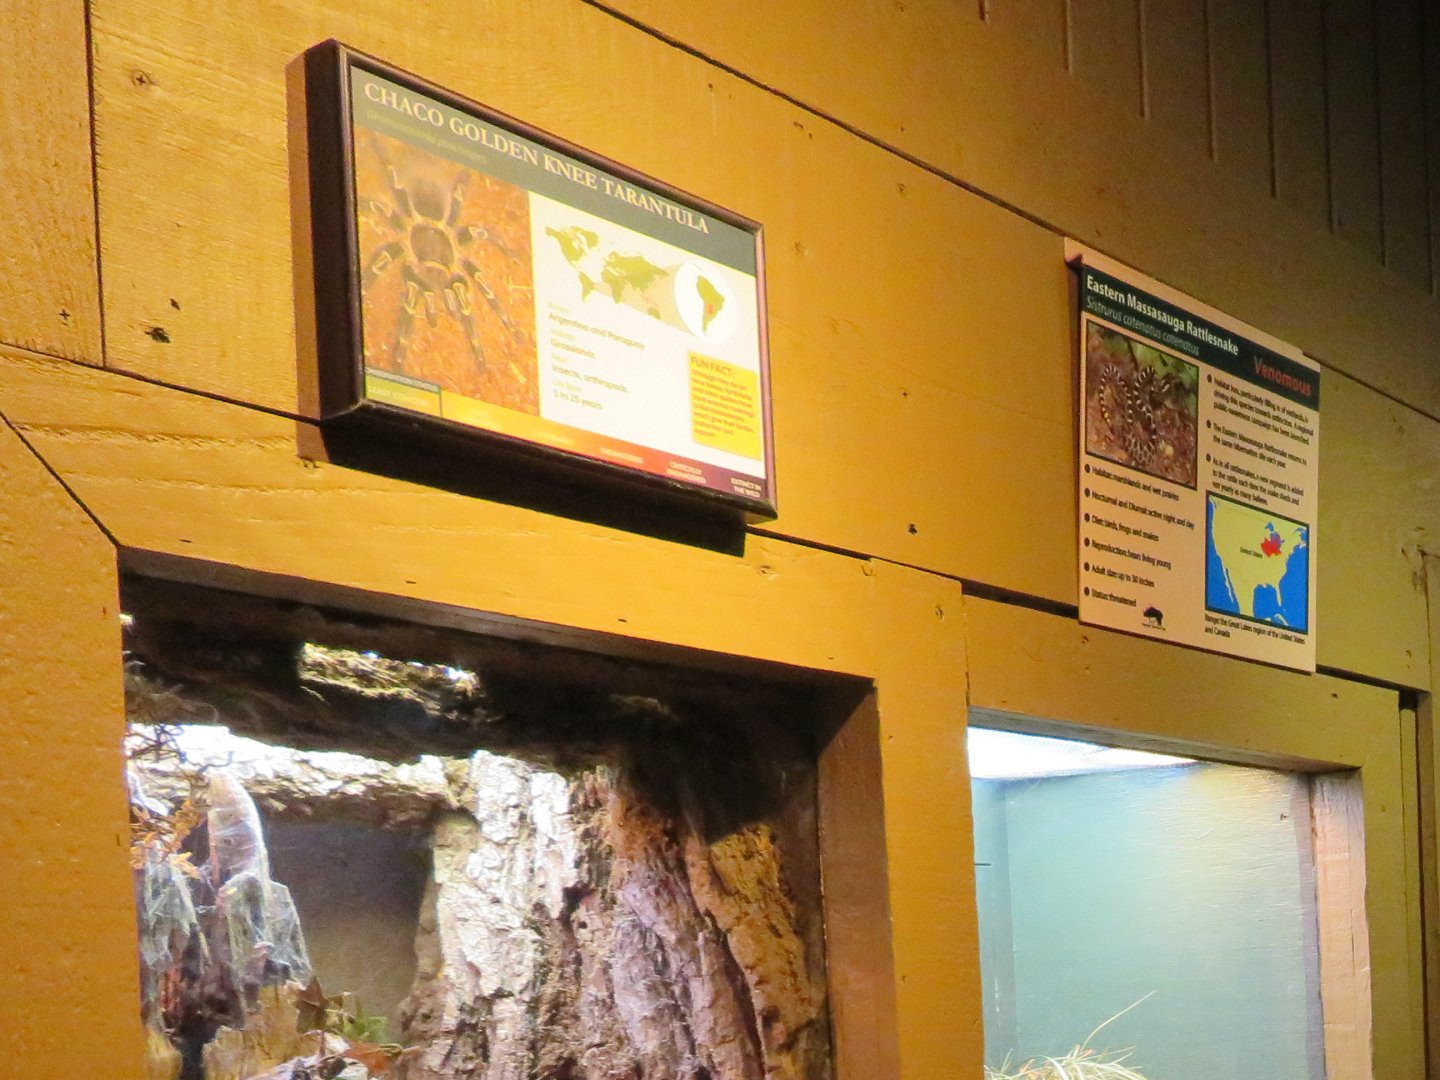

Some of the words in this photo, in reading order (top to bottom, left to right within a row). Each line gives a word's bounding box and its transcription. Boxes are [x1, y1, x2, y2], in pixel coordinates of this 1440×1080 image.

[363, 79, 445, 130] CHACO
[448, 114, 538, 167] GOLDEN
[543, 152, 597, 191] KNEE
[600, 176, 709, 236] TARANTULA
[1086, 274, 1125, 304] Eastern
[1126, 292, 1184, 335] Massasauga
[1186, 319, 1238, 356] Rattlesnake
[1253, 354, 1311, 398] Venomous
